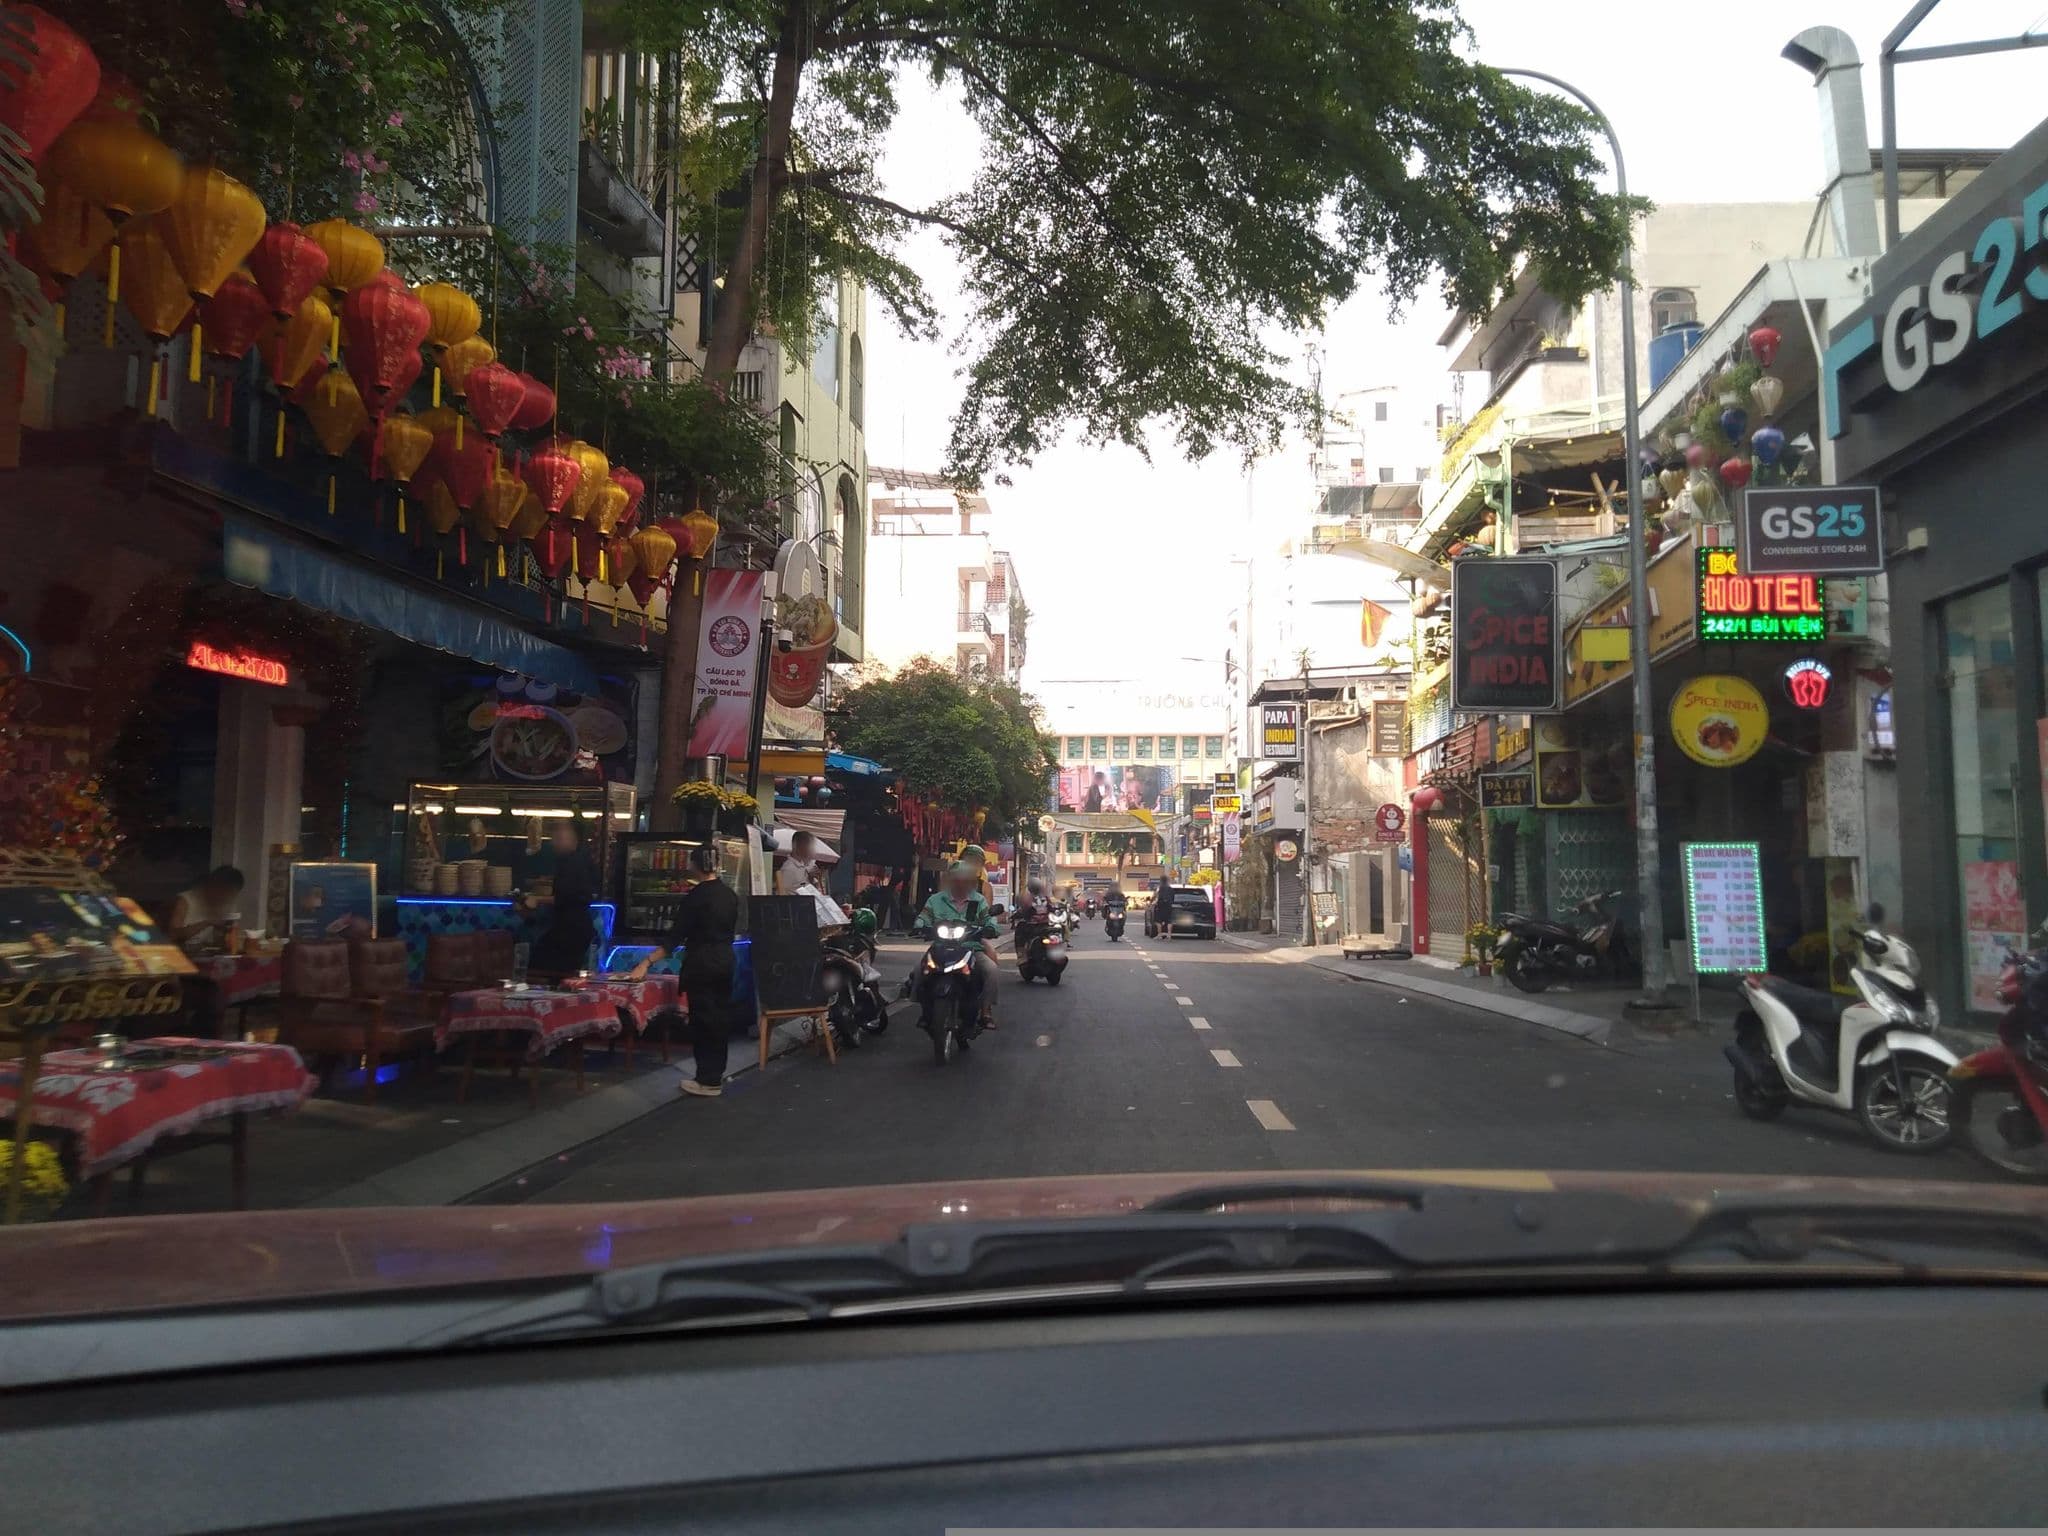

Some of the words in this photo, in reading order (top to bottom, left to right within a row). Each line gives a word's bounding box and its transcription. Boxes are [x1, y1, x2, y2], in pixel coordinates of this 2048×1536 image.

[1761, 503, 1866, 540] GS25
[1762, 545, 1819, 556] CONVENIENCE
[1821, 545, 1847, 554] STORE
[1848, 544, 1867, 553] 24H
[1704, 575, 1821, 613] HOTEL
[1465, 607, 1549, 651] SPICE
[1705, 618, 1746, 633] 242/1
[1750, 613, 1780, 633] BÙI
[1782, 615, 1821, 637] VIỆN
[1469, 655, 1549, 685] INDIA
[719, 688, 732, 696] CHÍ
[1684, 691, 1719, 708] SPICE
[1724, 698, 1760, 712] INDIA
[1265, 728, 1296, 743] INDIAN
[1265, 744, 1296, 755] RESTAURANT
[1492, 790, 1522, 804] 244
